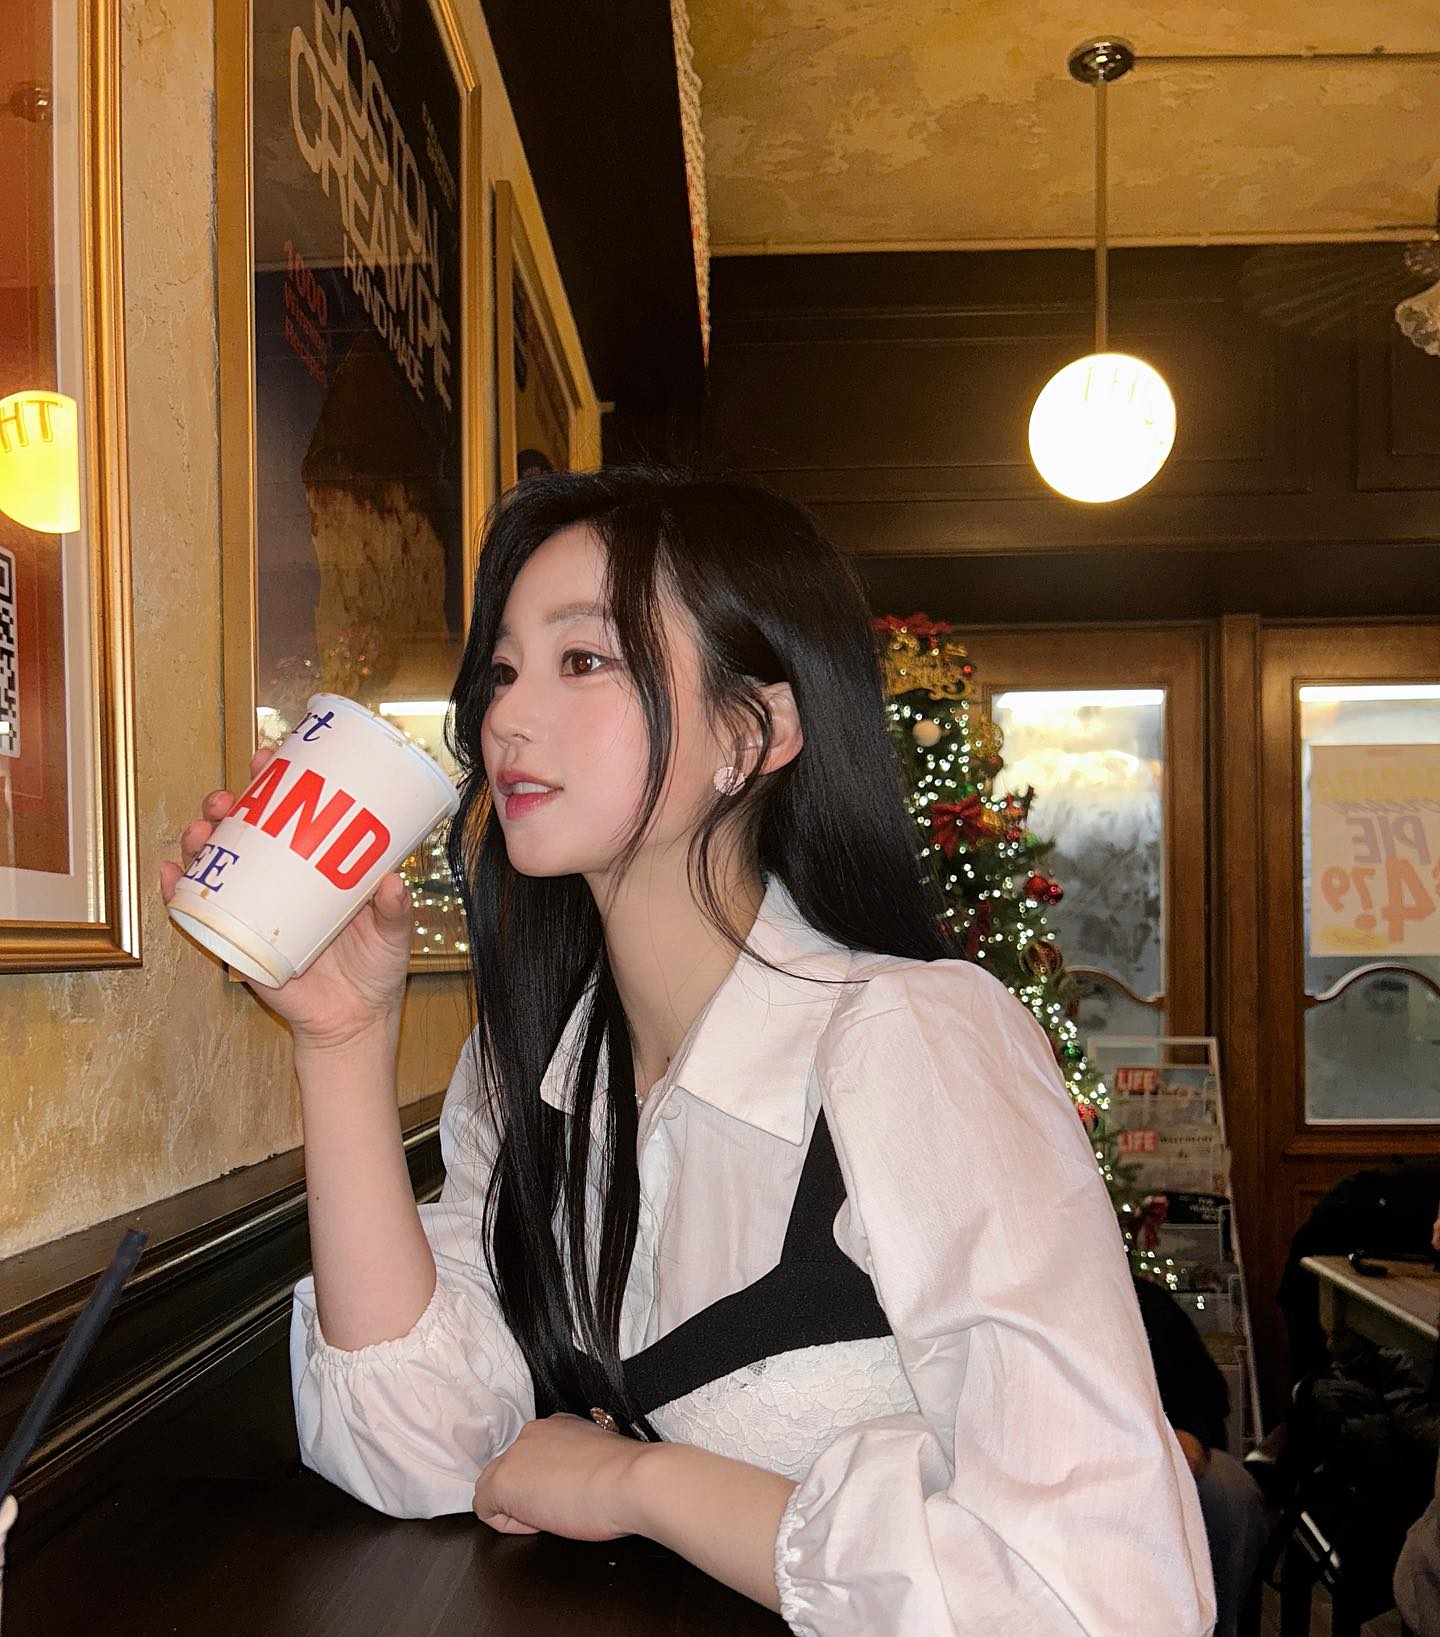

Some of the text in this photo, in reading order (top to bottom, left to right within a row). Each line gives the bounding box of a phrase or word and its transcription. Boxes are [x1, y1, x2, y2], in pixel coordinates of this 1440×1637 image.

[290, 26, 415, 345] CREAM
[1117, 1069, 1155, 1092] LIFE
[1118, 1130, 1156, 1152] LIFE
